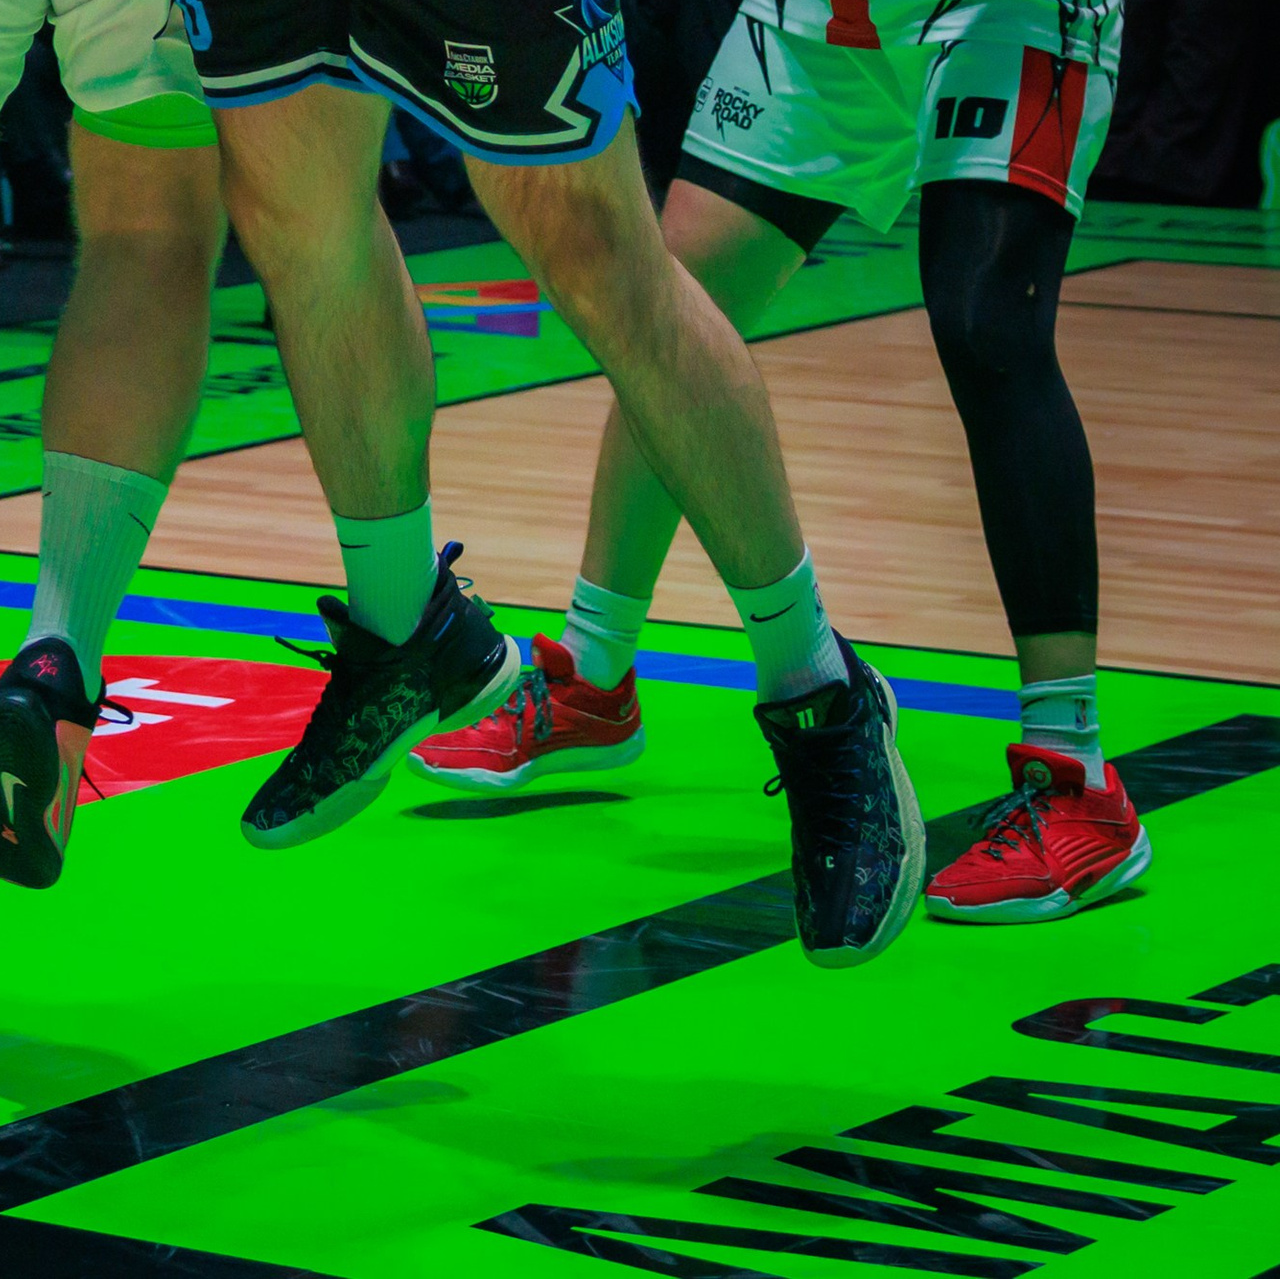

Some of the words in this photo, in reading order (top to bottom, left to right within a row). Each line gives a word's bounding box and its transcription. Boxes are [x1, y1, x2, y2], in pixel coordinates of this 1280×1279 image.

[444, 70, 496, 82] BASKET
[446, 61, 496, 75] MEDIA
[711, 103, 753, 130] ROAD
[714, 88, 765, 119] ROCKY
[934, 97, 1009, 139] 10
